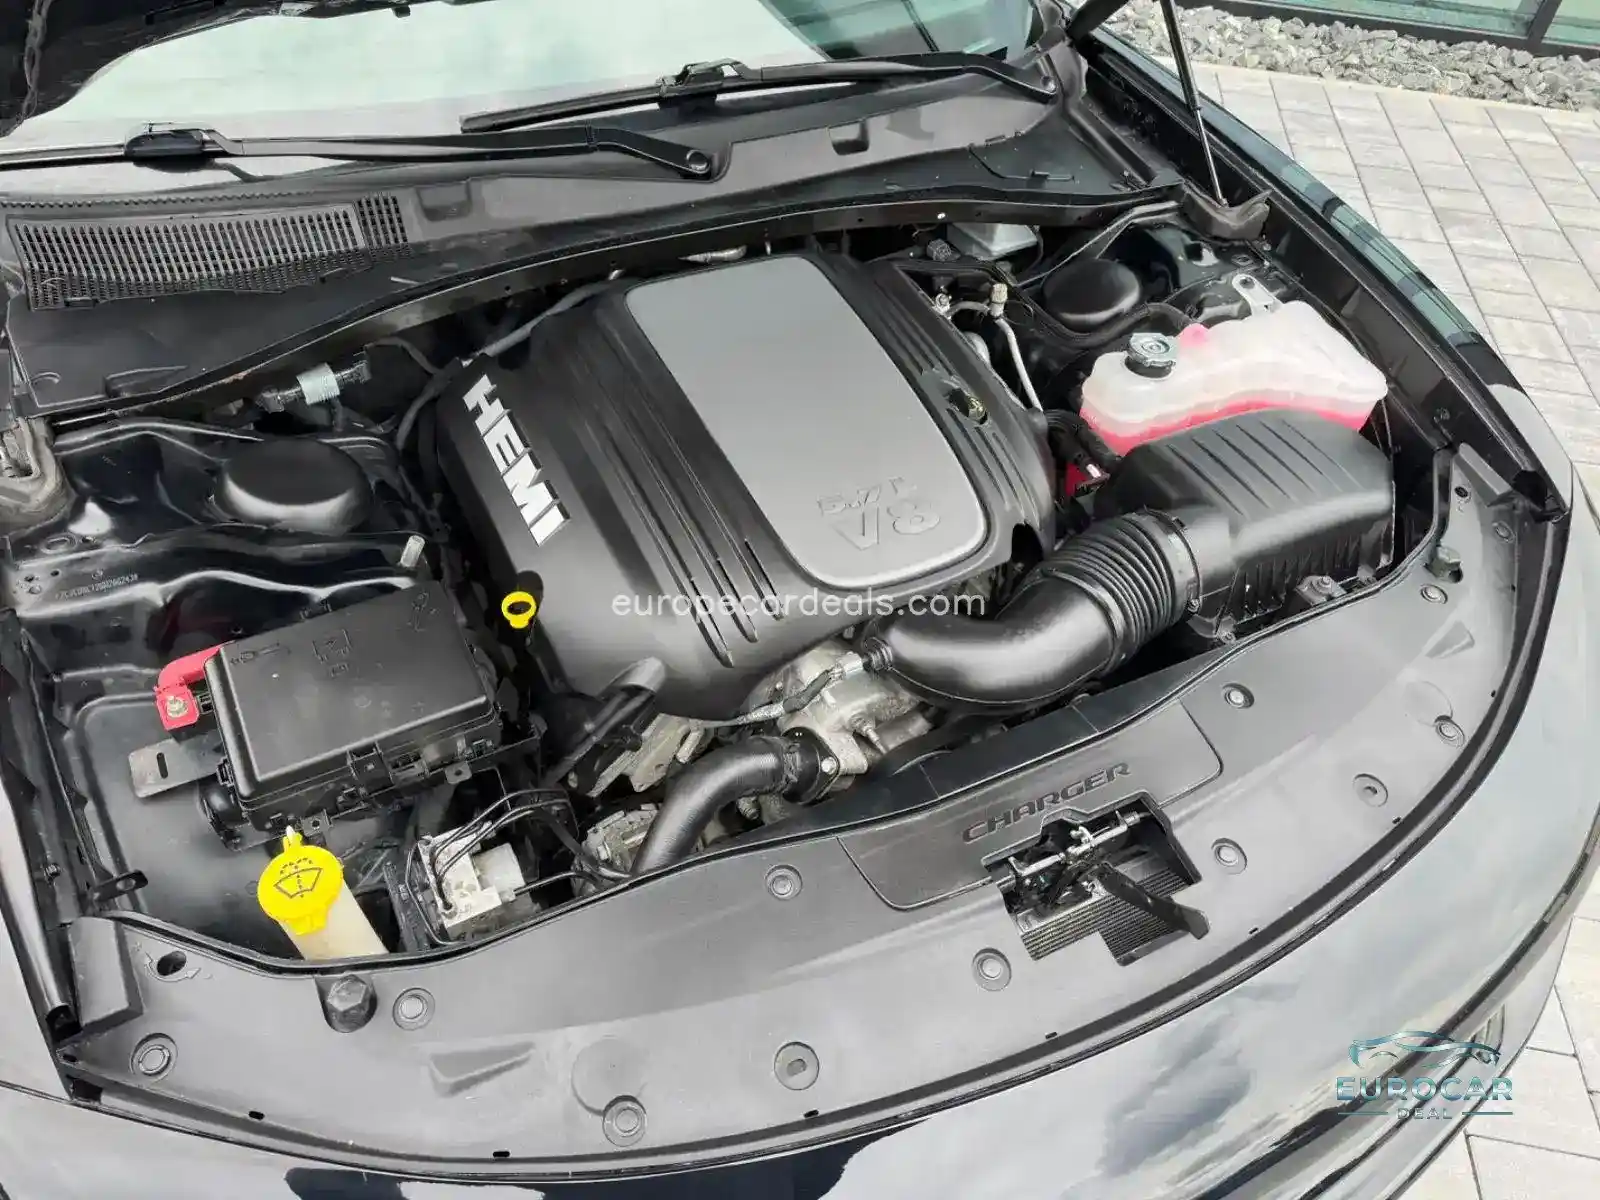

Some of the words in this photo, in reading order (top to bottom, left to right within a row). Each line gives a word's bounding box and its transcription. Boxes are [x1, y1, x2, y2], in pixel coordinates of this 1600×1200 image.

[462, 374, 570, 547] HEMI
[828, 498, 941, 551] V8
[962, 762, 1132, 843] CHARGER
